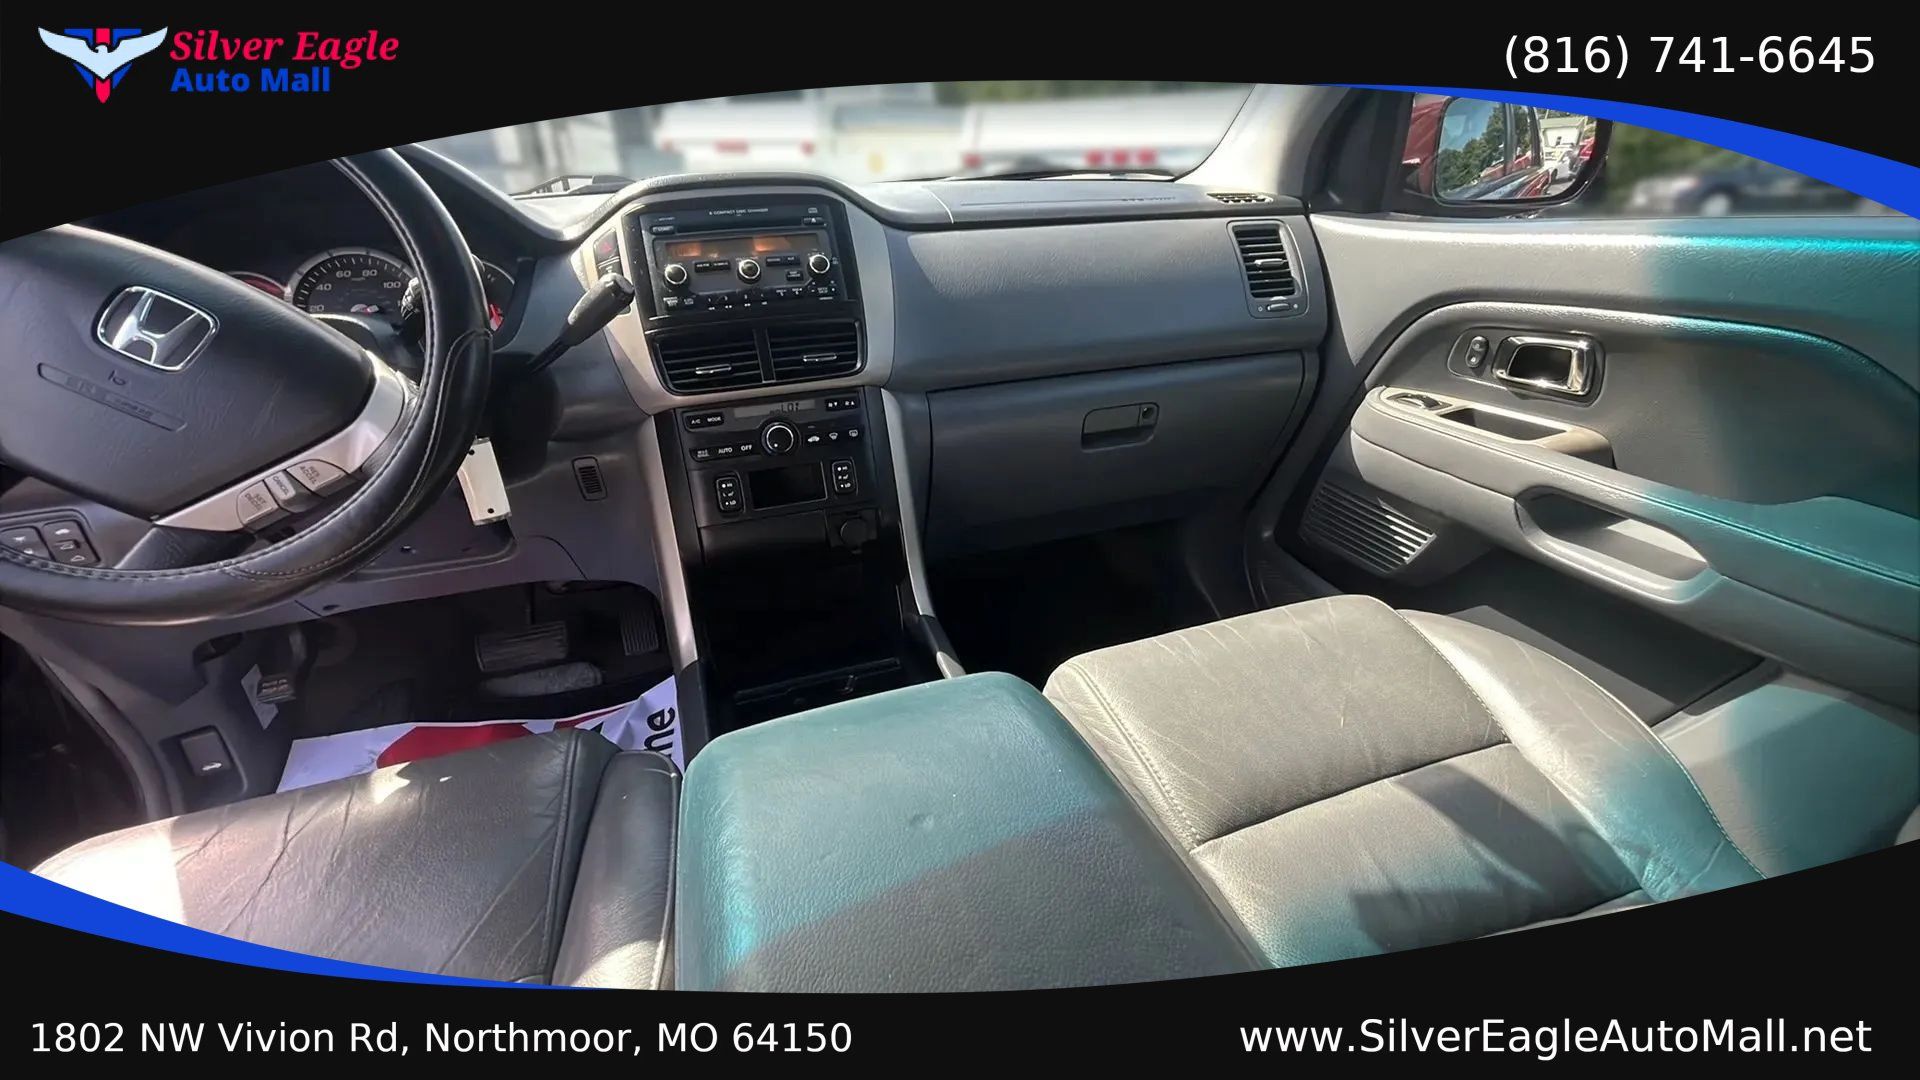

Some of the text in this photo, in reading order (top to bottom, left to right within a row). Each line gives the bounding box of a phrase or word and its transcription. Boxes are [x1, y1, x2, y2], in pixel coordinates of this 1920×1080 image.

[335, 269, 352, 278] 60
[361, 269, 378, 277] 80
[316, 283, 332, 291] 40
[383, 281, 401, 289] 100
[643, 706, 676, 760] ne
